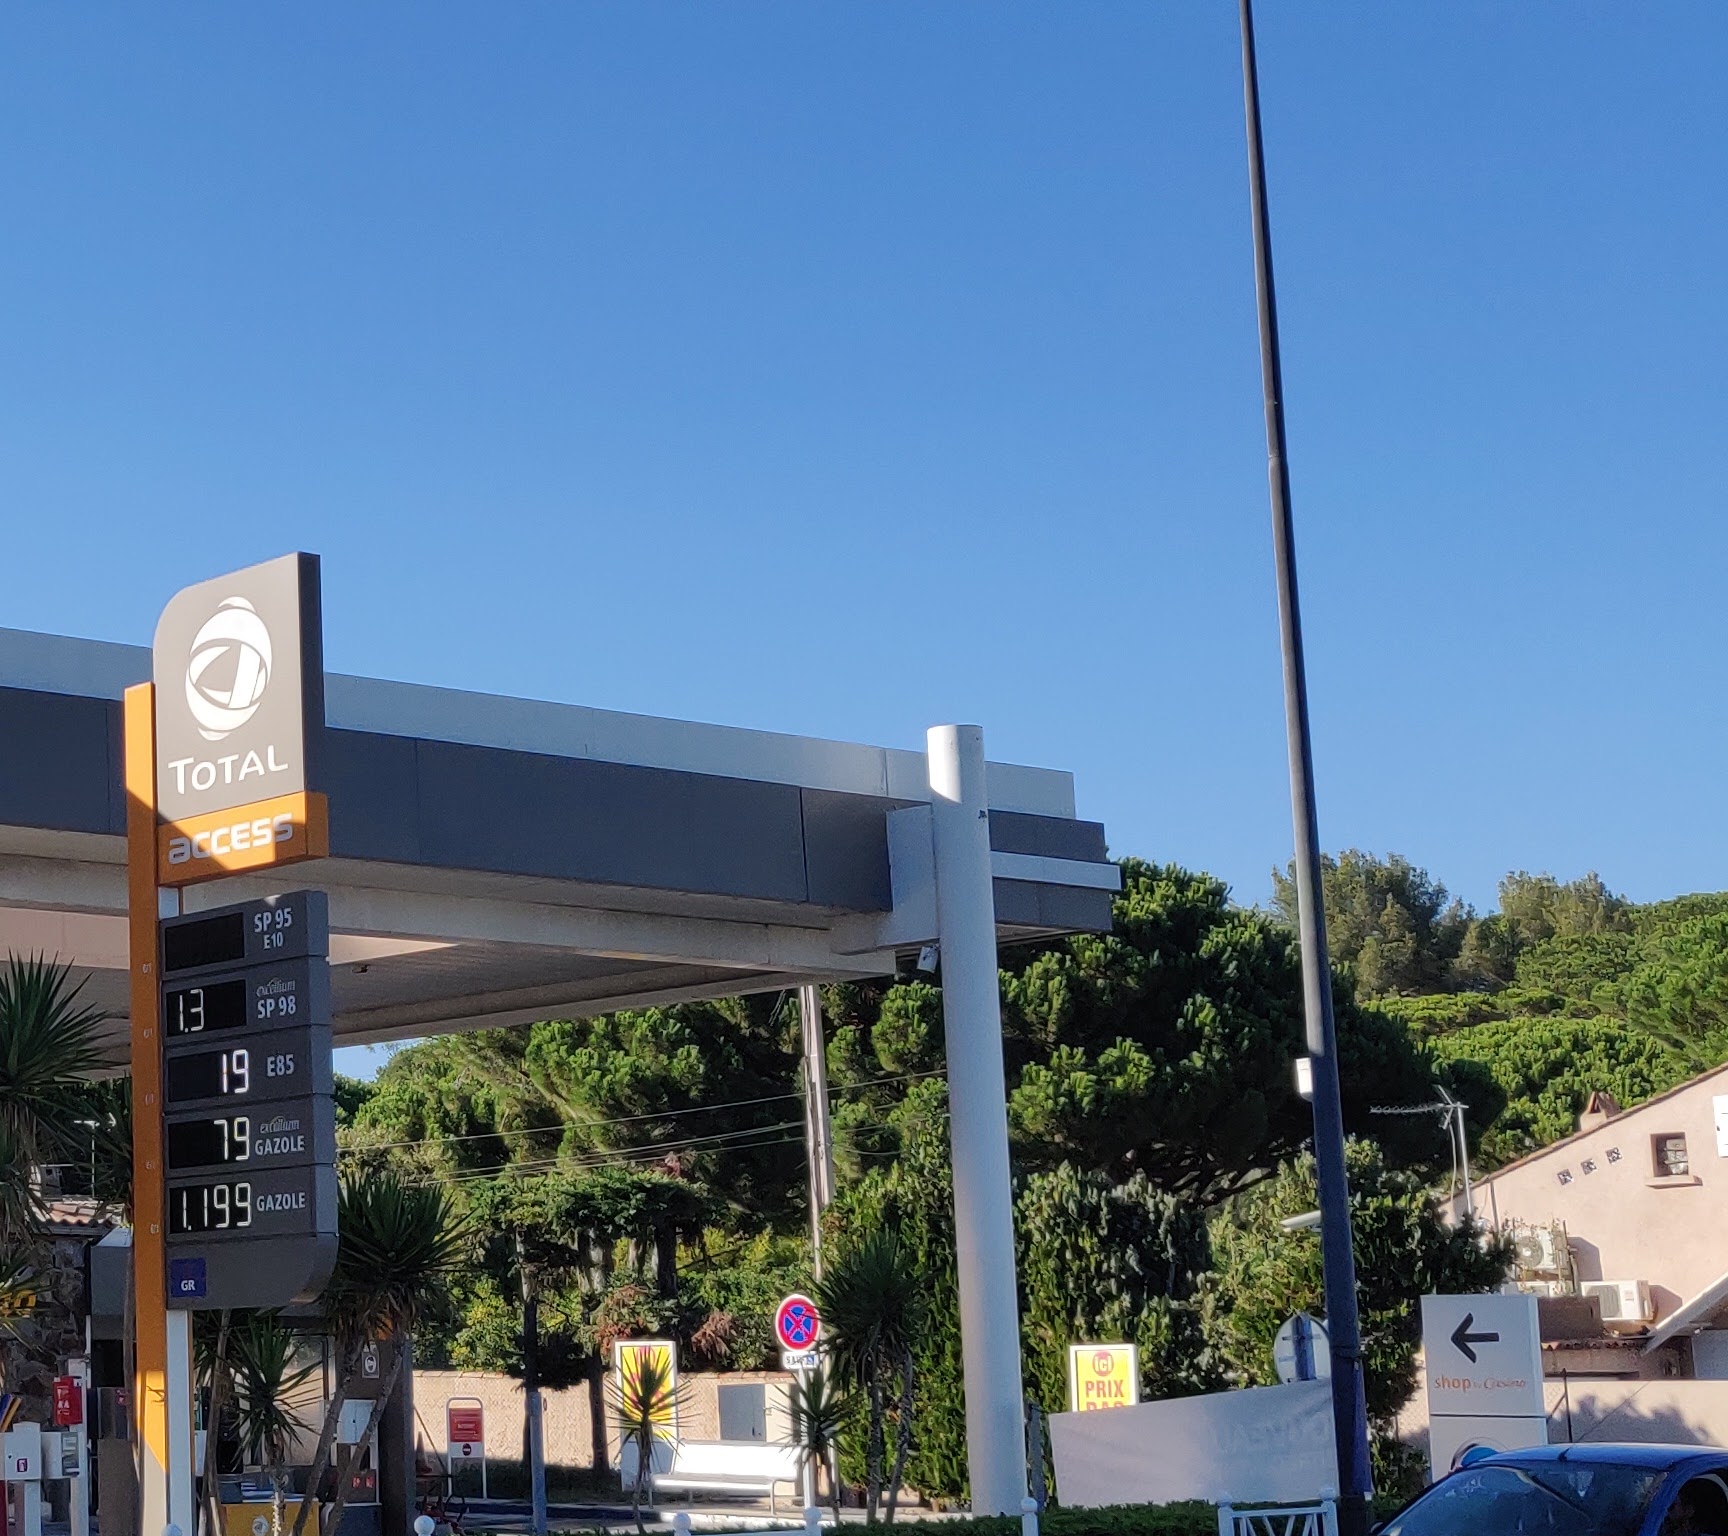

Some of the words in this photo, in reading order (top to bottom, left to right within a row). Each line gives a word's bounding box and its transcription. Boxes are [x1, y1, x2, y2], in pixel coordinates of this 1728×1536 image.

[168, 745, 289, 795] TOTAL
[254, 911, 272, 933] SP
[275, 907, 293, 929] 95
[263, 932, 284, 950] E10
[257, 998, 275, 1019] SP
[278, 995, 296, 1016] 98
[222, 1049, 249, 1093] 19
[266, 1054, 294, 1077] E85
[214, 1116, 250, 1161] 79
[255, 1135, 305, 1156] GAZOLE
[183, 1182, 251, 1231] 1.199
[256, 1192, 306, 1212] GAZOLE
[180, 1279, 196, 1292] GR
[1085, 1379, 1124, 1398] PRIX
[1434, 1374, 1472, 1393] shop
